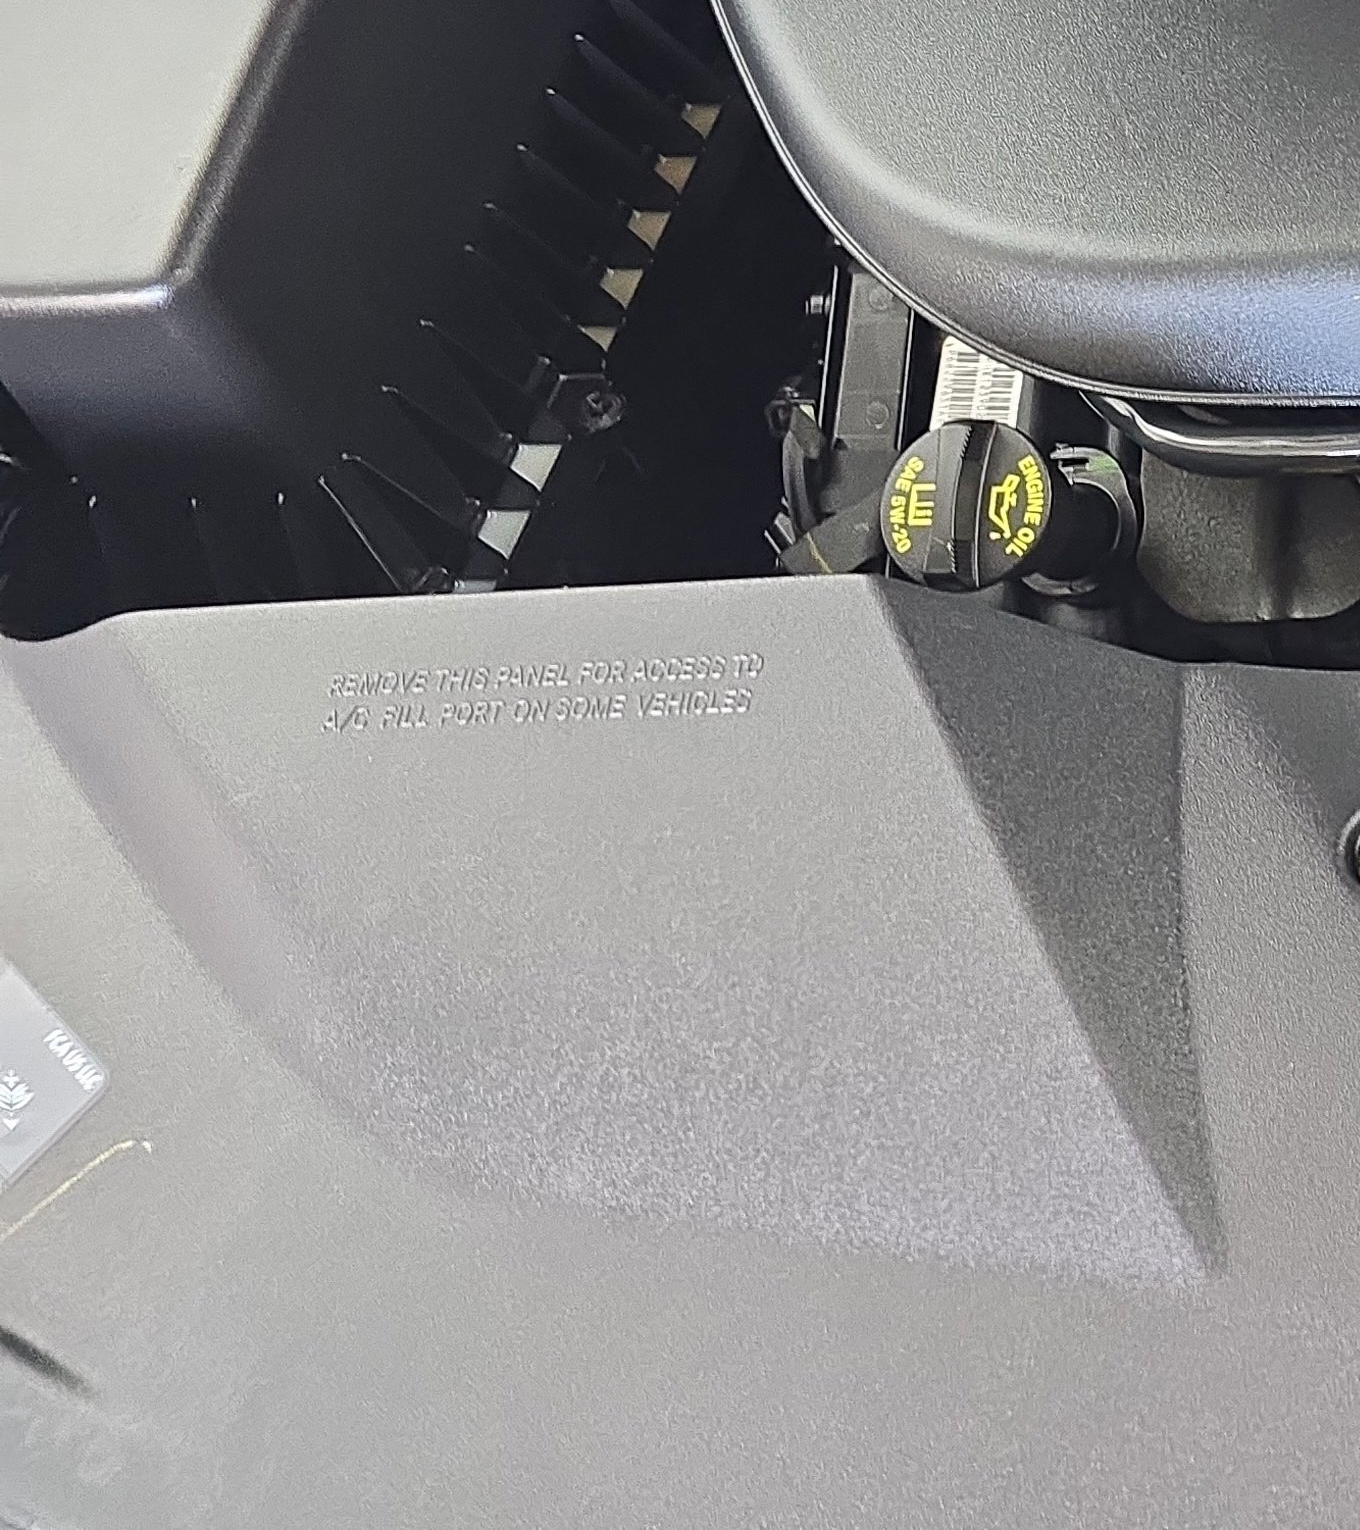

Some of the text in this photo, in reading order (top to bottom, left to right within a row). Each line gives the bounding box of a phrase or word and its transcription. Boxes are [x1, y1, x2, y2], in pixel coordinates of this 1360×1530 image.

[888, 457, 924, 555] SAE 5W-20
[1005, 454, 1044, 557] ENGINE OIL
[320, 688, 752, 735] A/C FILL PORT ON SOME VEHICLES
[327, 652, 765, 700] REMOVE THIS PANEL FOR ACCESS TO
